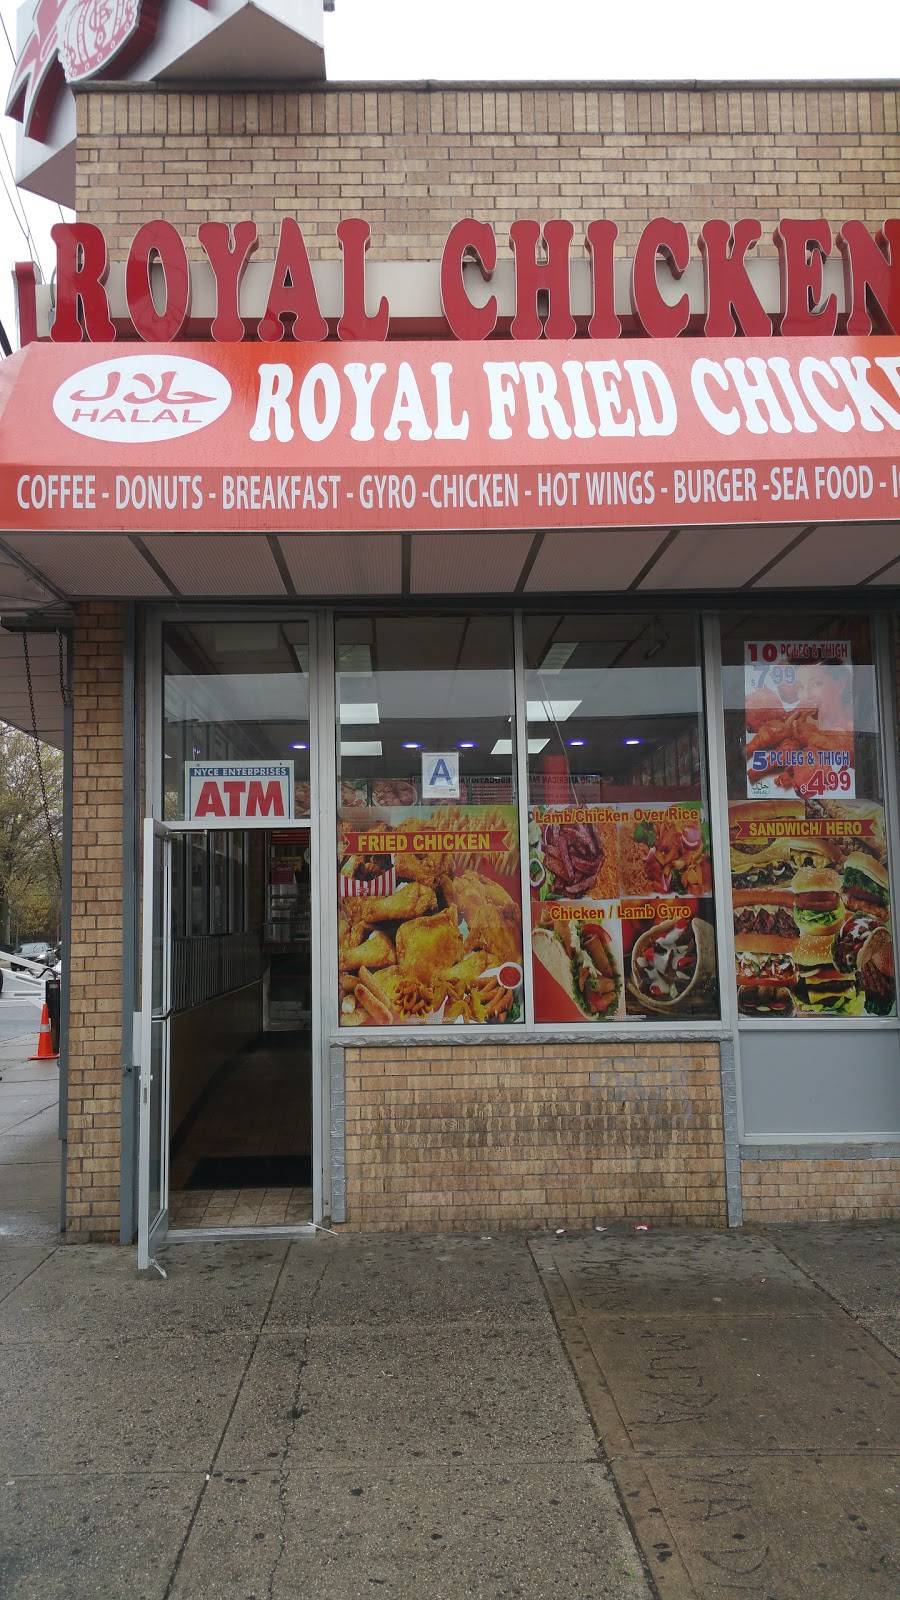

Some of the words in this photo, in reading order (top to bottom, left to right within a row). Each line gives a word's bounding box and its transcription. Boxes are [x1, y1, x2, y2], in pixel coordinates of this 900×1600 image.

[50, 216, 390, 343] ROYAL
[249, 361, 470, 443] ROYAL
[482, 358, 678, 441] FRIED
[690, 355, 900, 436] CHICK
[71, 408, 203, 423] HALAL
[16, 474, 97, 510] COFFEE
[115, 474, 204, 511] DONUTS
[222, 474, 342, 511] BREAKFAST
[359, 474, 417, 509] GYRO
[537, 472, 580, 506] HOT
[585, 470, 656, 506] WINGS
[673, 467, 757, 504] BURGER
[814, 464, 875, 500] FOOD
[747, 643, 778, 662] 10
[752, 751, 768, 771] 5
[770, 751, 782, 766] PC
[785, 751, 804, 765] LEG
[807, 751, 815, 765] &
[818, 751, 850, 765] THIGH
[194, 768, 219, 776] NYCE
[222, 767, 287, 776] ENTERPRISES
[429, 758, 453, 785] A
[194, 780, 285, 817] ATM
[532, 807, 630, 824] Lamb/Chicken
[632, 807, 667, 822] Over
[668, 806, 699, 821] Rice
[826, 820, 863, 836] HERO
[358, 834, 408, 852] FRIED
[412, 833, 490, 851] CHICKEN
[550, 906, 605, 921] Chicken
[617, 904, 656, 919] Lamb
[657, 902, 692, 921] Gyro
